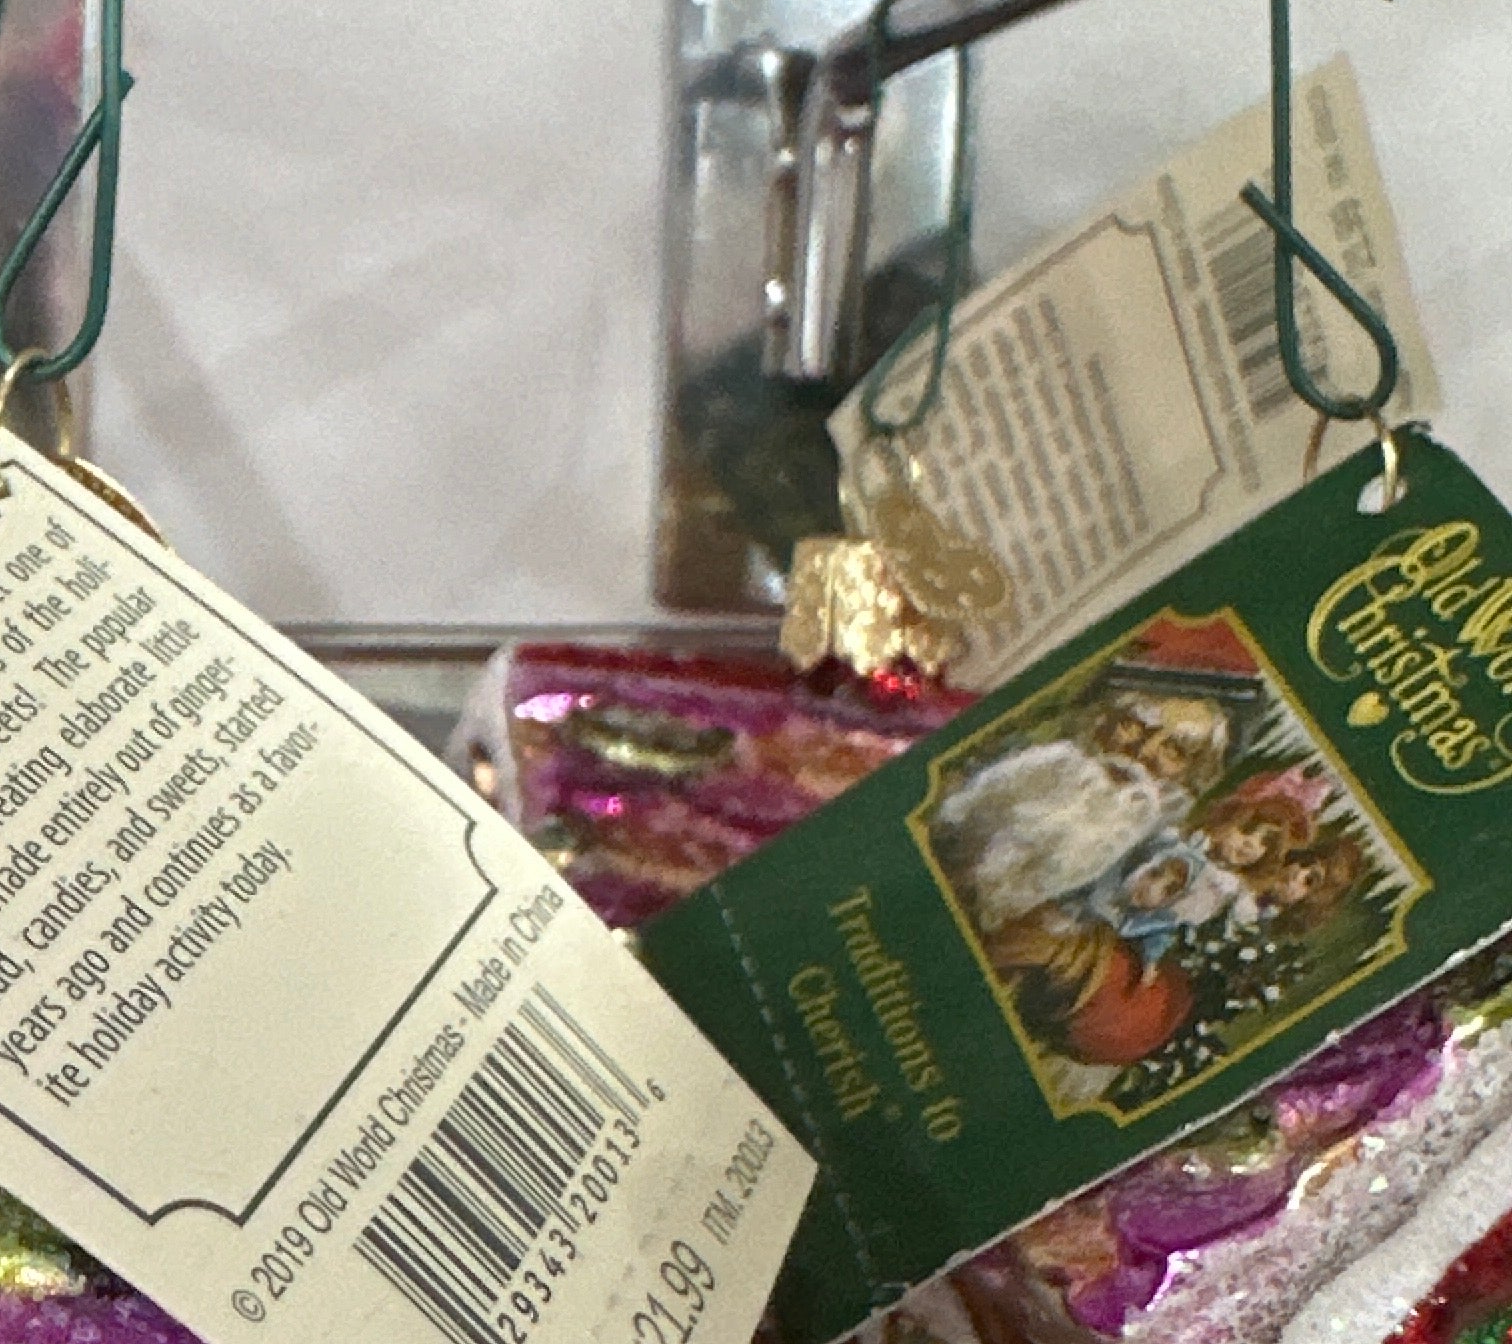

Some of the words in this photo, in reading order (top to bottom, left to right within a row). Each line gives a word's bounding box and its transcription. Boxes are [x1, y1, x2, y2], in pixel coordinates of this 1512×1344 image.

[3, 543, 52, 583] one
[43, 514, 76, 551] of
[1376, 521, 1501, 620] Old
[0, 616, 35, 654] of
[21, 593, 72, 632] the
[52, 554, 112, 602] holi-
[31, 648, 91, 689] The
[77, 585, 156, 664] popular
[57, 660, 157, 750] elaborate
[137, 618, 201, 667] little
[1307, 554, 1491, 772] Christmas
[39, 761, 131, 847] entirely
[114, 727, 162, 773] out
[147, 701, 181, 740] of
[167, 655, 234, 728] ginger-
[227, 782, 263, 815] as
[250, 769, 279, 792] a
[256, 721, 318, 778] favor-
[20, 860, 121, 951] candies,
[105, 805, 158, 863] and
[145, 747, 230, 822] sweets,
[212, 677, 285, 754] started
[142, 806, 241, 908] continues
[99, 893, 154, 954] and
[492, 935, 529, 967] in
[507, 883, 565, 944] China
[35, 1062, 90, 1108] ite
[65, 972, 172, 1070] holiday
[153, 895, 242, 983] activity
[218, 839, 292, 904] today.
[55, 948, 111, 1002] ago
[450, 956, 512, 1021] Made
[826, 884, 944, 1093] Traditions
[920, 1094, 963, 1143] to
[376, 1023, 466, 1127] Christmas
[787, 963, 882, 1123] Cherish
[325, 1113, 397, 1191] World
[699, 1188, 745, 1246] ITM.
[723, 1117, 775, 1200] 20013
[296, 1177, 349, 1235] Old
[249, 1224, 315, 1301] 2019
